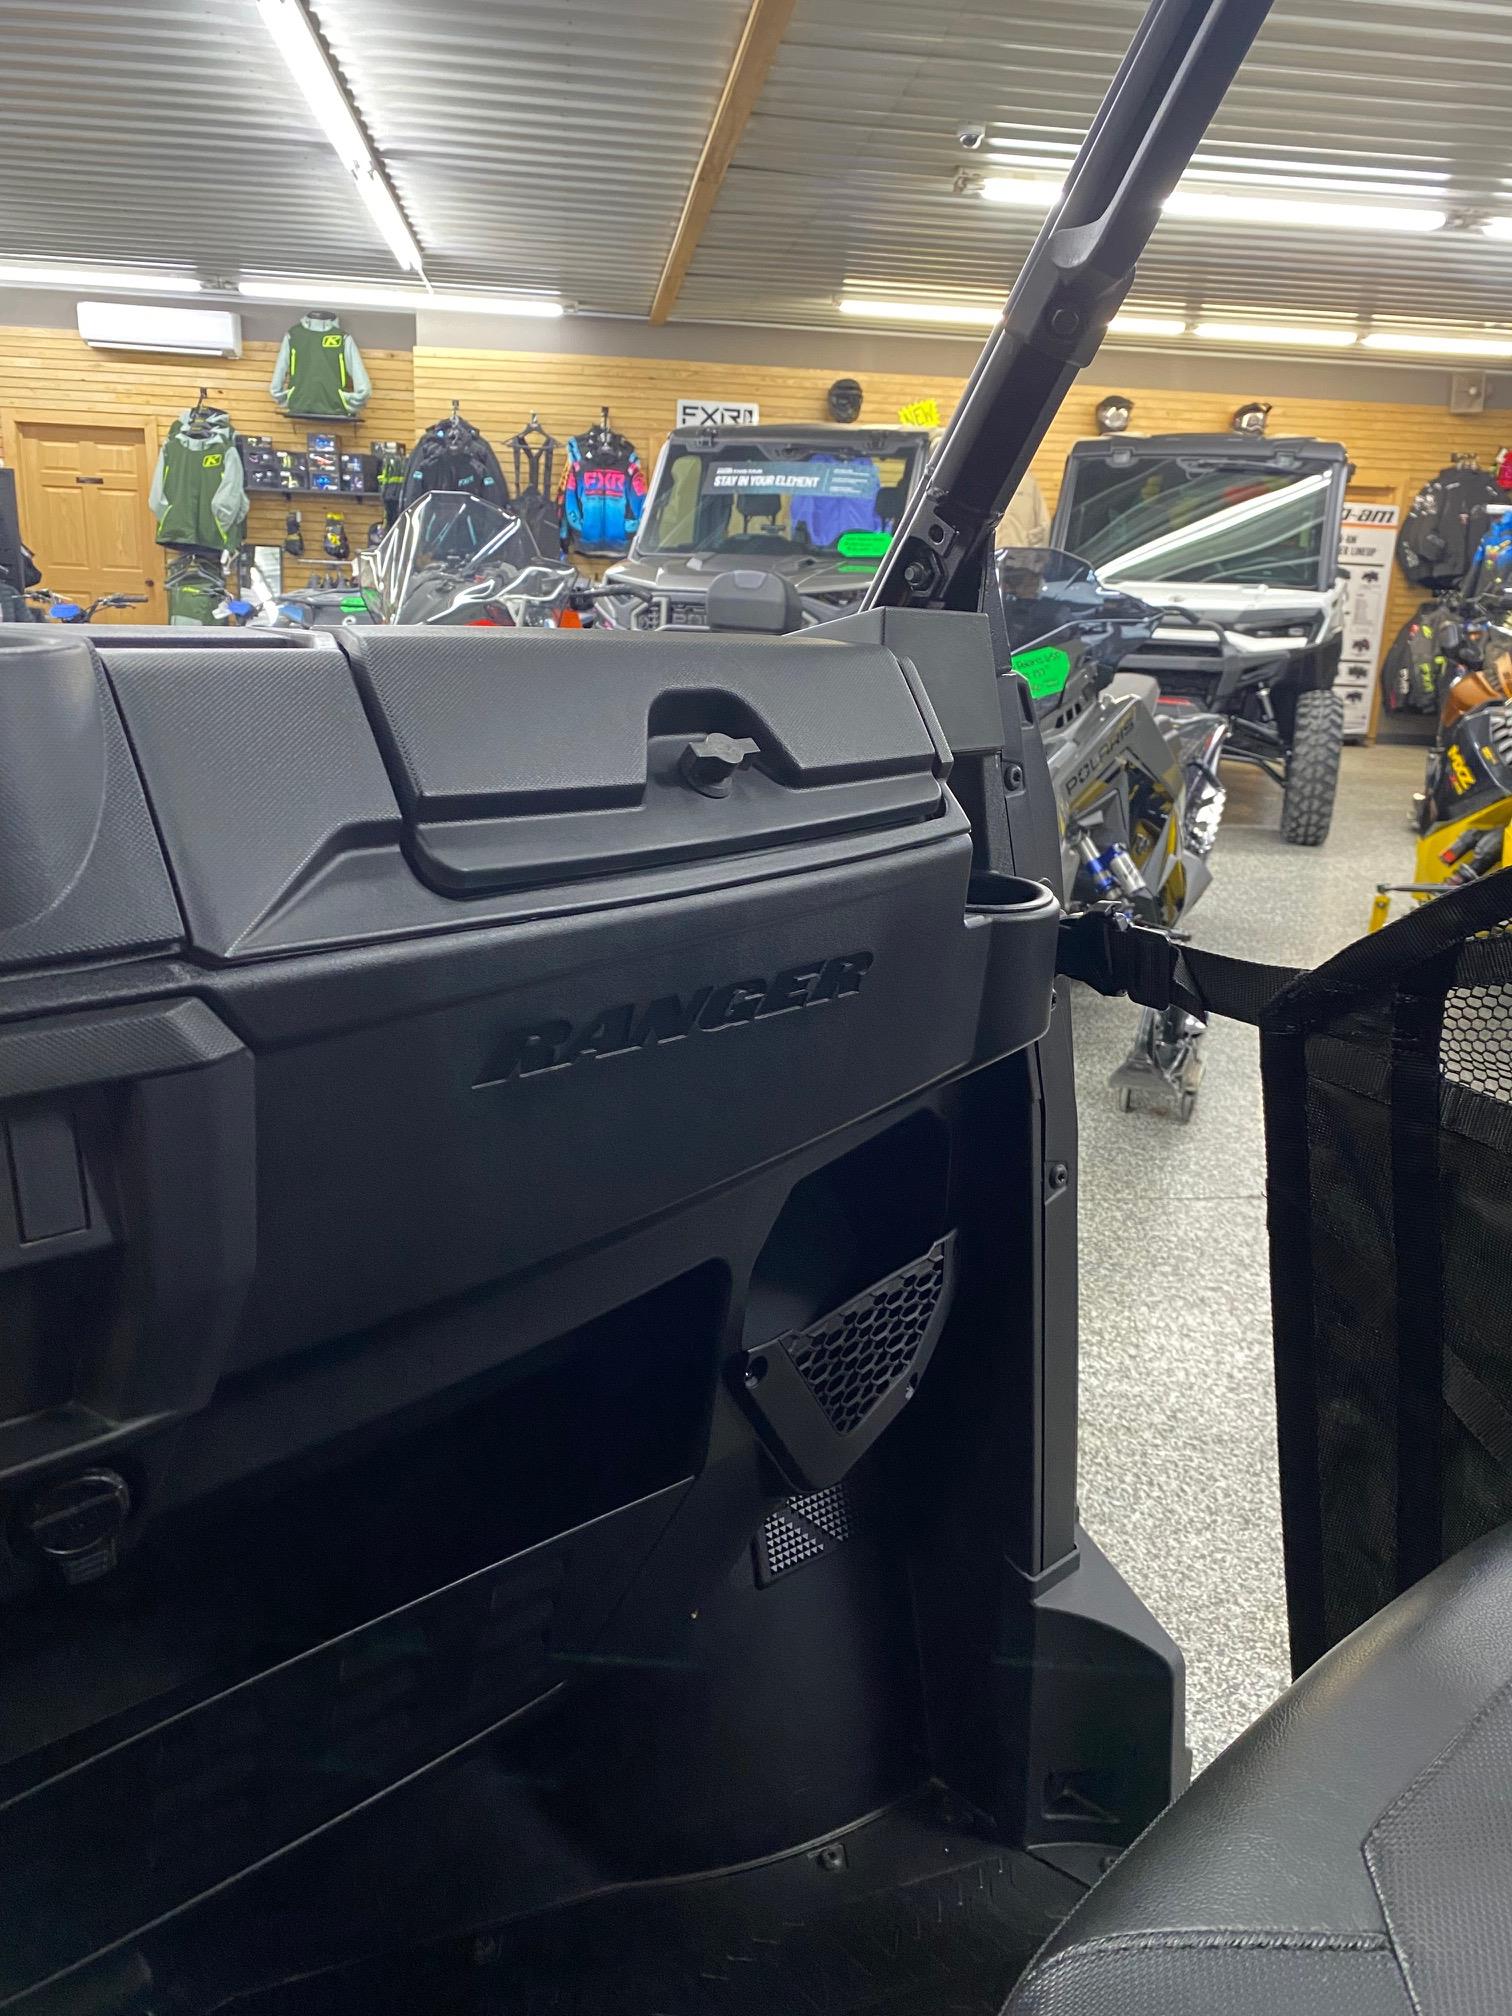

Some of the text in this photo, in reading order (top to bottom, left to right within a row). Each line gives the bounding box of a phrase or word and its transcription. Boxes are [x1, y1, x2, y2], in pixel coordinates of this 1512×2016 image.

[682, 406, 741, 425] FXR
[584, 471, 625, 490] FXR
[713, 475, 737, 488] STAY
[737, 476, 749, 487] IN
[750, 476, 775, 487] YOUR
[775, 476, 820, 489] ELEMENT
[1066, 721, 1134, 797] POLARIS
[472, 950, 875, 1090] RANGER
